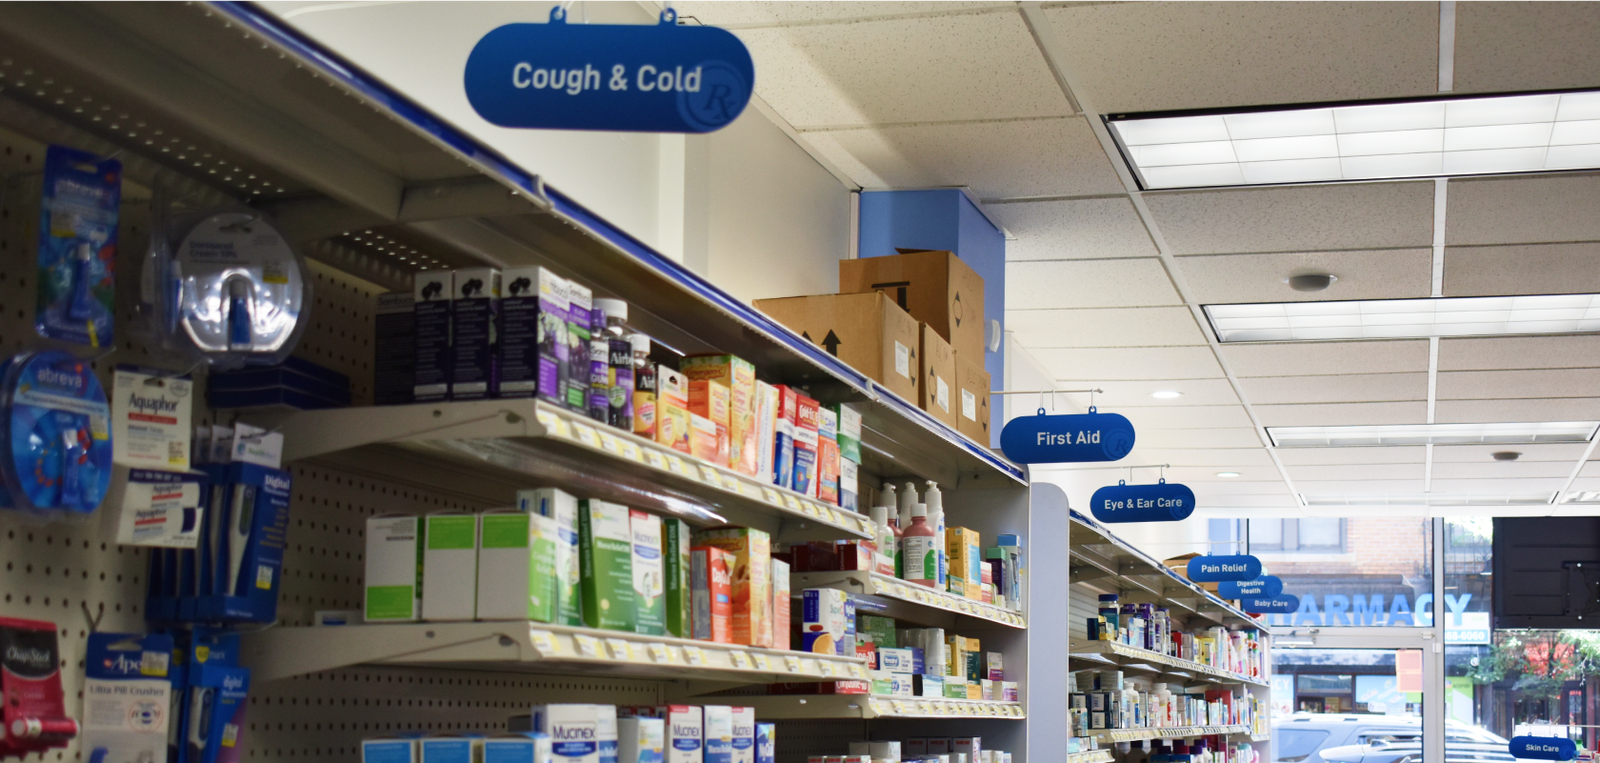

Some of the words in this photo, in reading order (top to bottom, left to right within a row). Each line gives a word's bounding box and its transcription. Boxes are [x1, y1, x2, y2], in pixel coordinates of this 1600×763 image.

[512, 62, 600, 95] Cough
[609, 64, 628, 91] &
[637, 65, 702, 92] Cold
[378, 296, 415, 306] Sambuco
[610, 352, 632, 365] Airb
[37, 366, 83, 388] abreva
[129, 392, 179, 415] Aquaphor
[1037, 432, 1072, 446] First
[1076, 430, 1101, 444] Aid
[153, 484, 182, 493] Aquaphor
[264, 474, 290, 490] Digital
[1104, 499, 1124, 511] Eye
[1126, 499, 1134, 509] &
[1136, 498, 1155, 509] Ear
[1157, 497, 1182, 508] Care
[136, 508, 167, 520] Aquaphor
[669, 540, 677, 563] Relief
[1201, 565, 1219, 573] Pain
[1221, 564, 1247, 572] Relief
[1445, 631, 1485, 641] 68-6060
[6, 646, 51, 663] ChapStick
[112, 653, 142, 673] Ape
[90, 685, 111, 695] Ultra
[113, 685, 127, 696] Pill
[129, 687, 164, 697] Crusher
[1525, 743, 1541, 751] Skin
